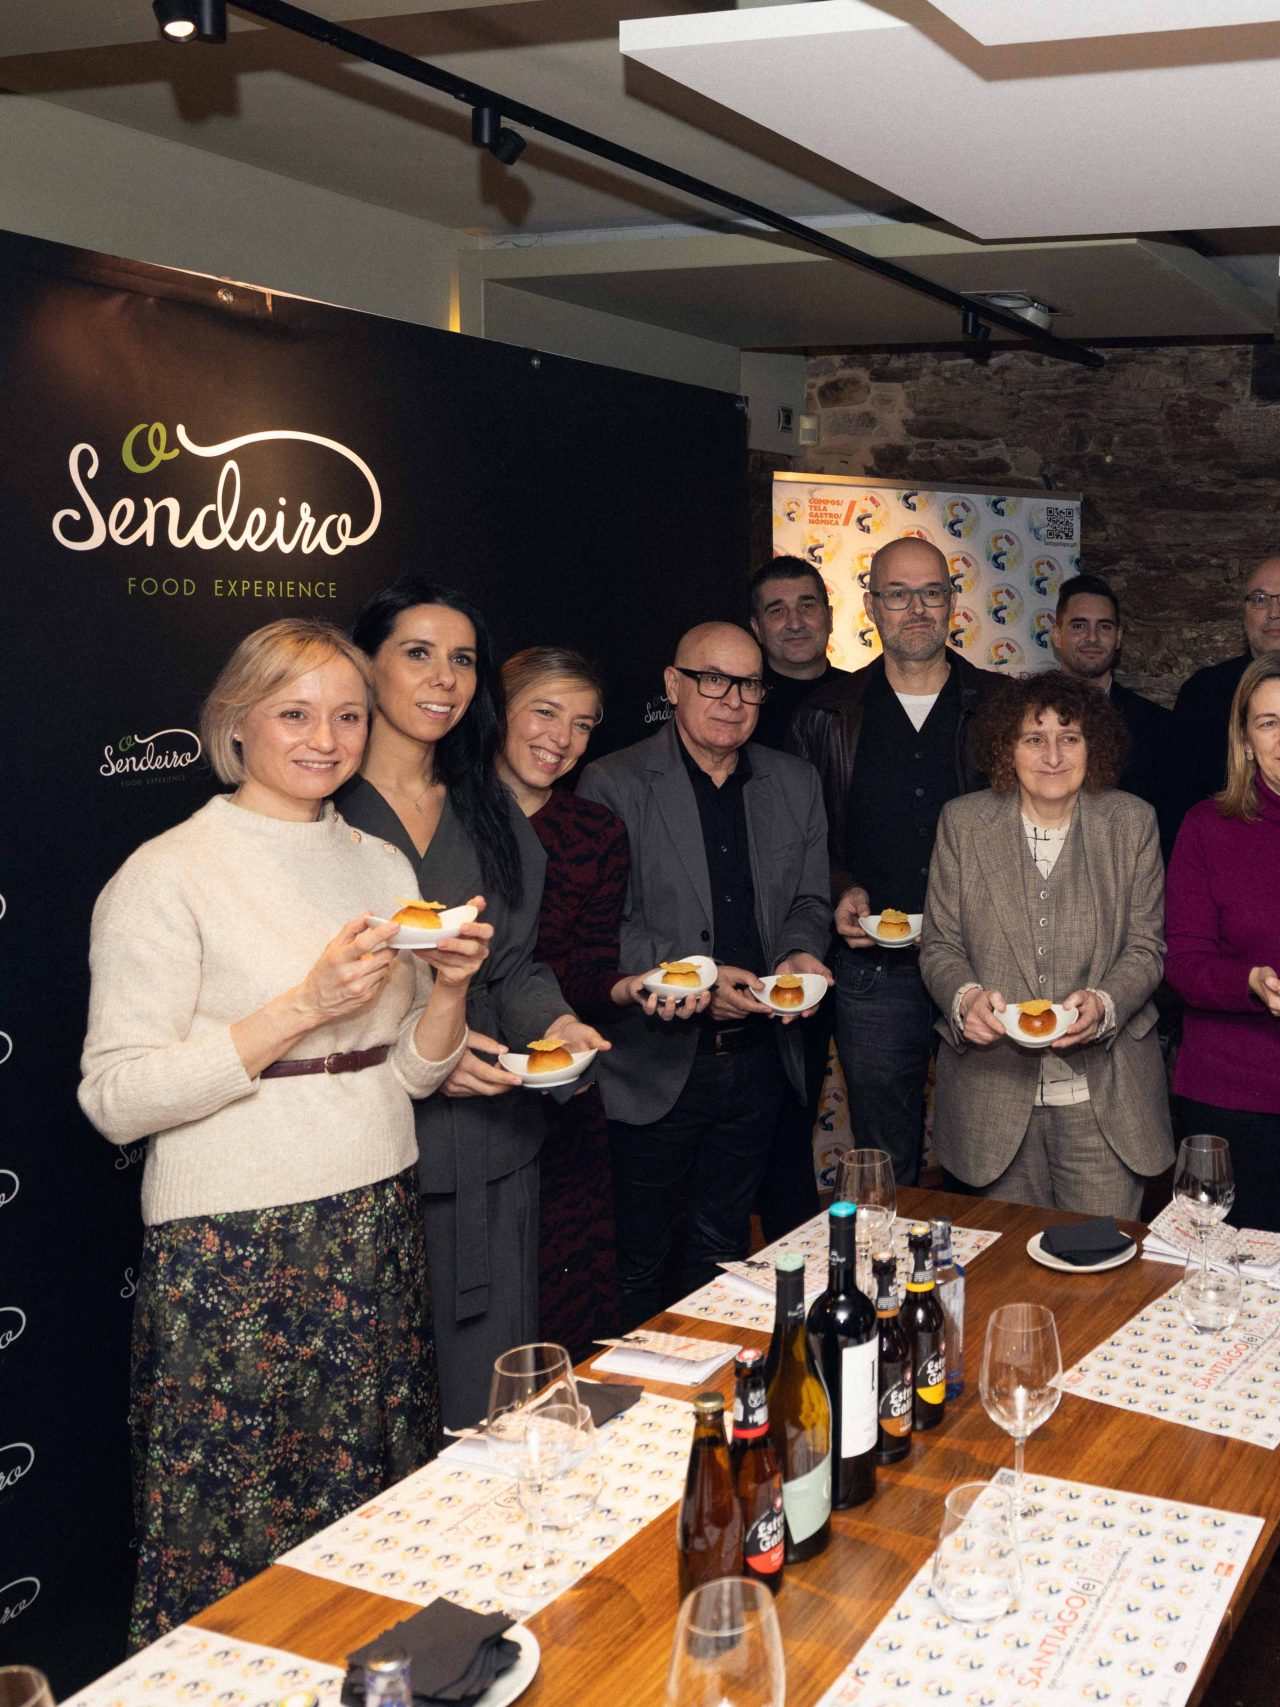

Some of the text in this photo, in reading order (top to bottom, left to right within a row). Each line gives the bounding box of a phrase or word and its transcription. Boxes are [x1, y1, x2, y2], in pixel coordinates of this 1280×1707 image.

[52, 423, 382, 556] Sendeiro
[127, 577, 338, 599] FOOD EXPERIENCE
[99, 728, 202, 777] Sendeiro
